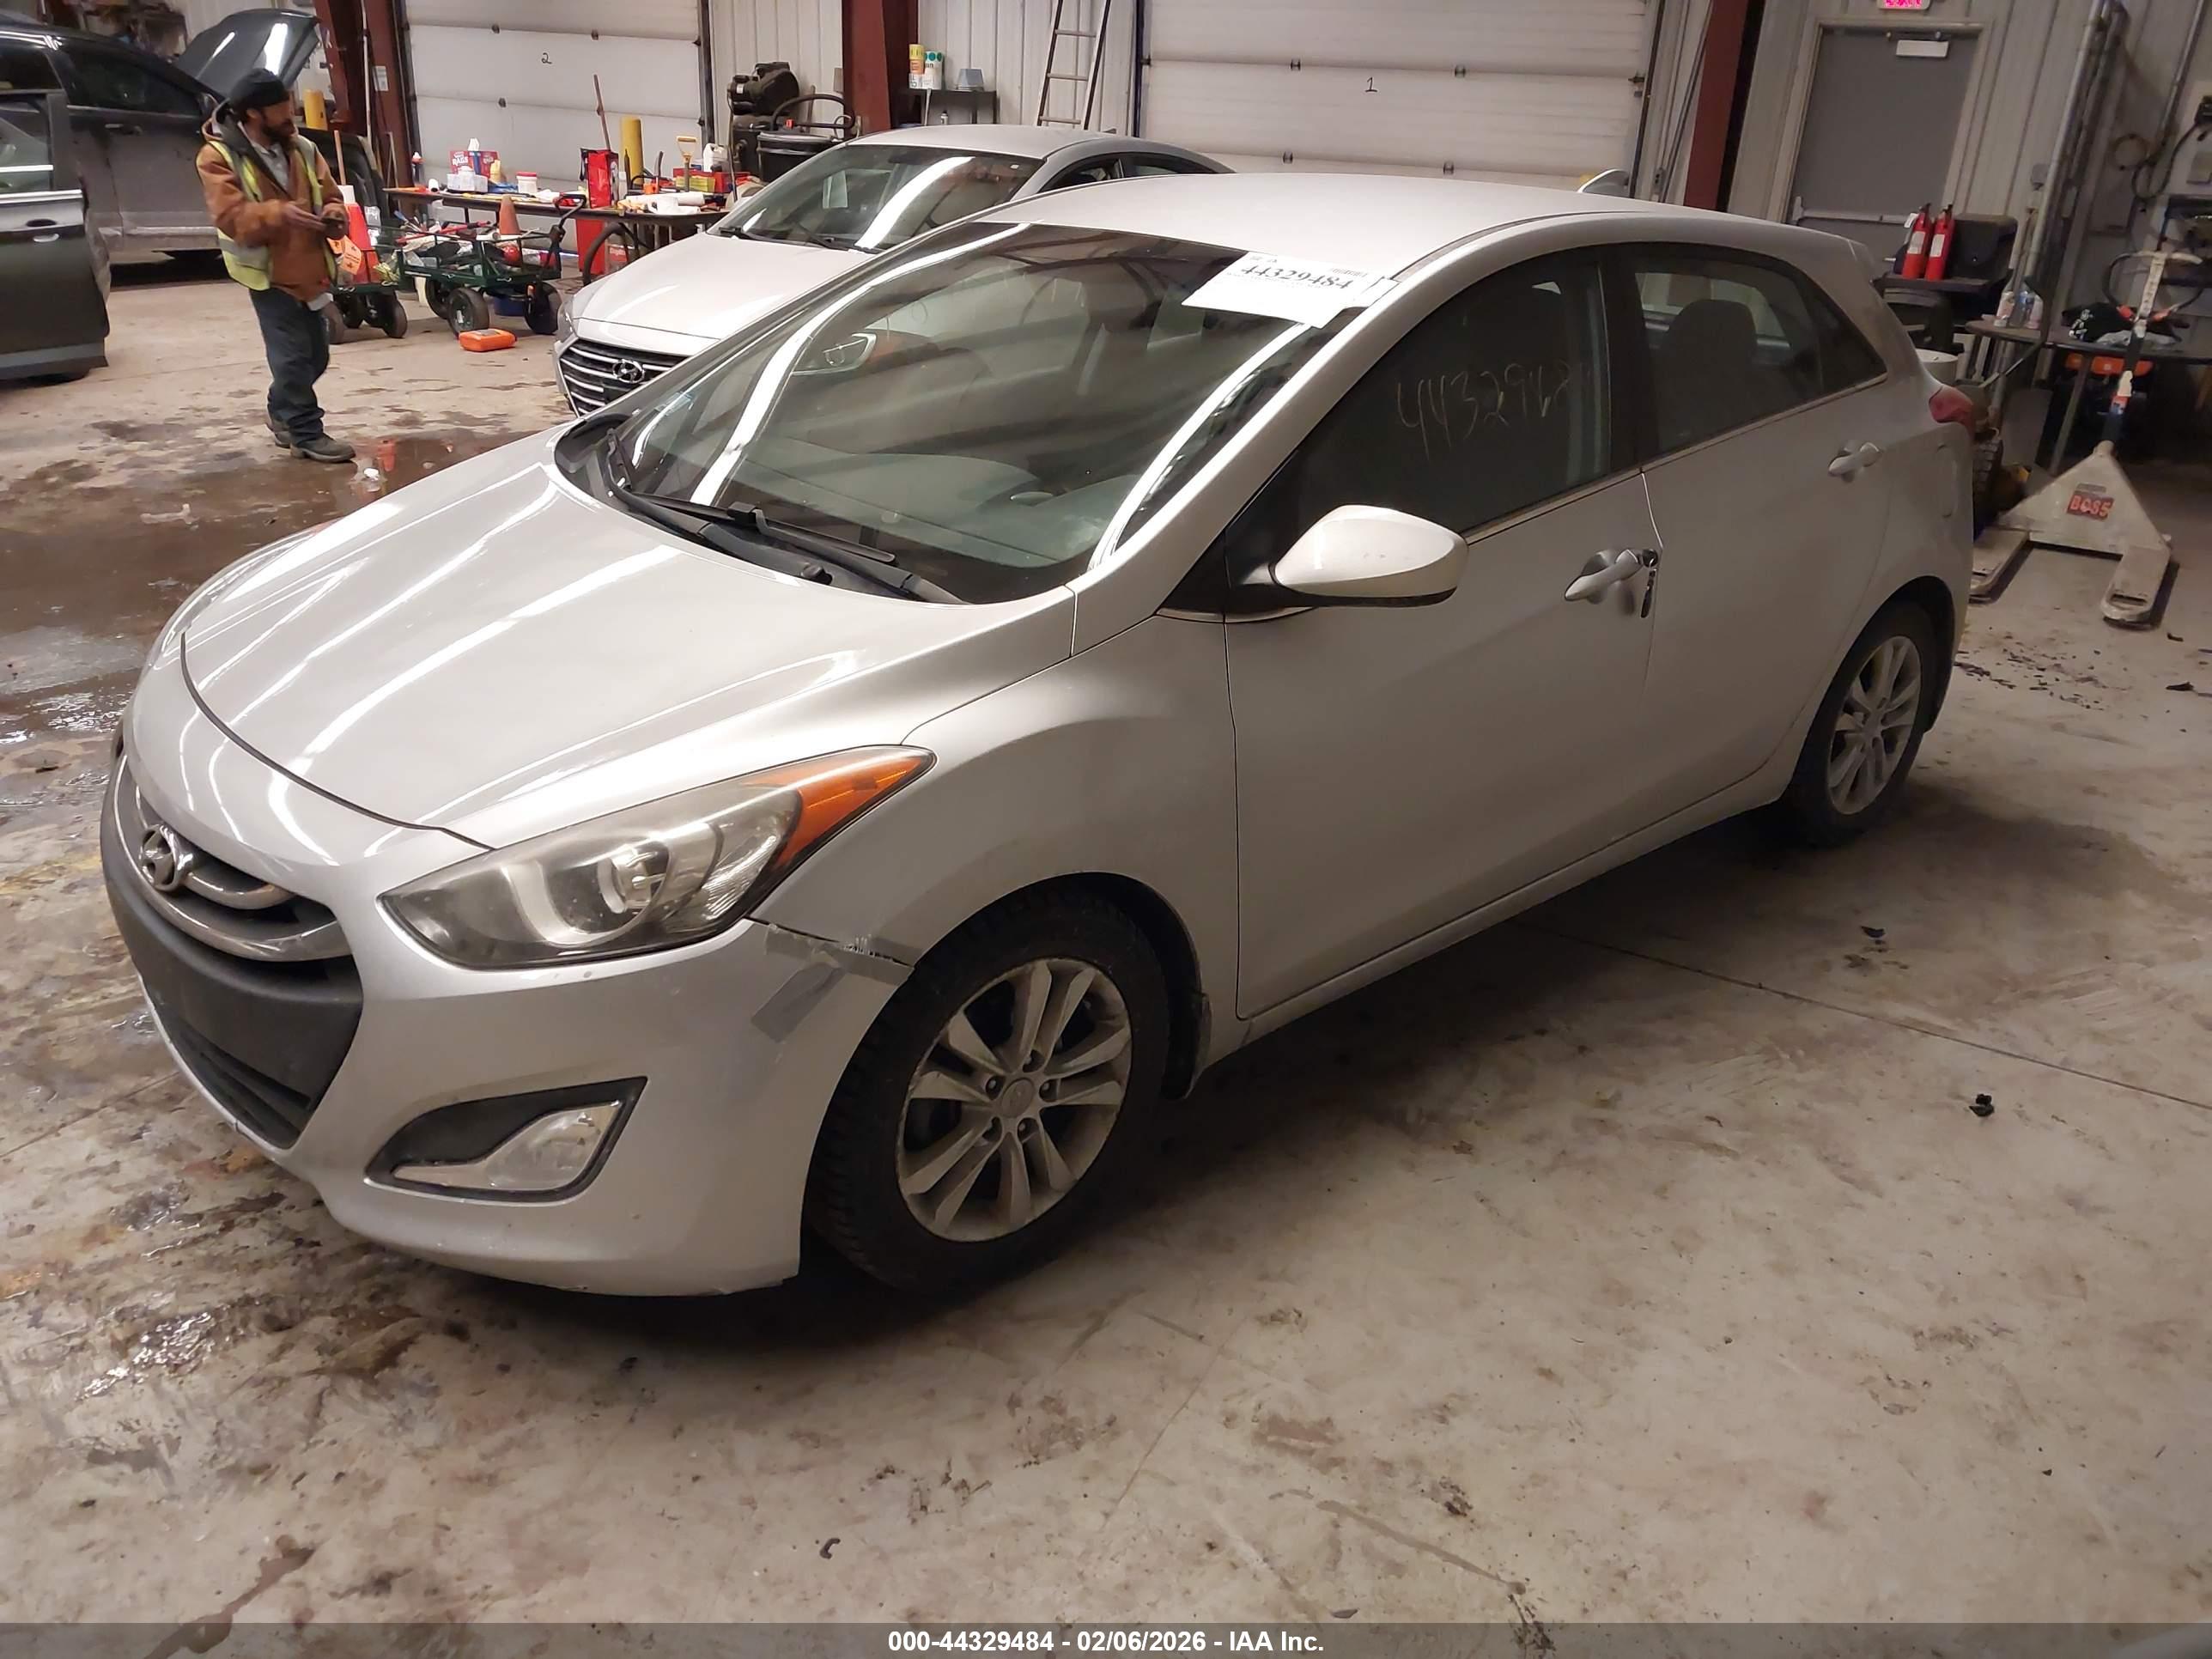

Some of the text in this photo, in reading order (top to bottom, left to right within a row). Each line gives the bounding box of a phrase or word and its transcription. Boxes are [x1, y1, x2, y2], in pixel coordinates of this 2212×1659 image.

[541, 52, 552, 64] 2
[1364, 76, 1377, 93] 1
[1241, 265, 1354, 289] 44329484
